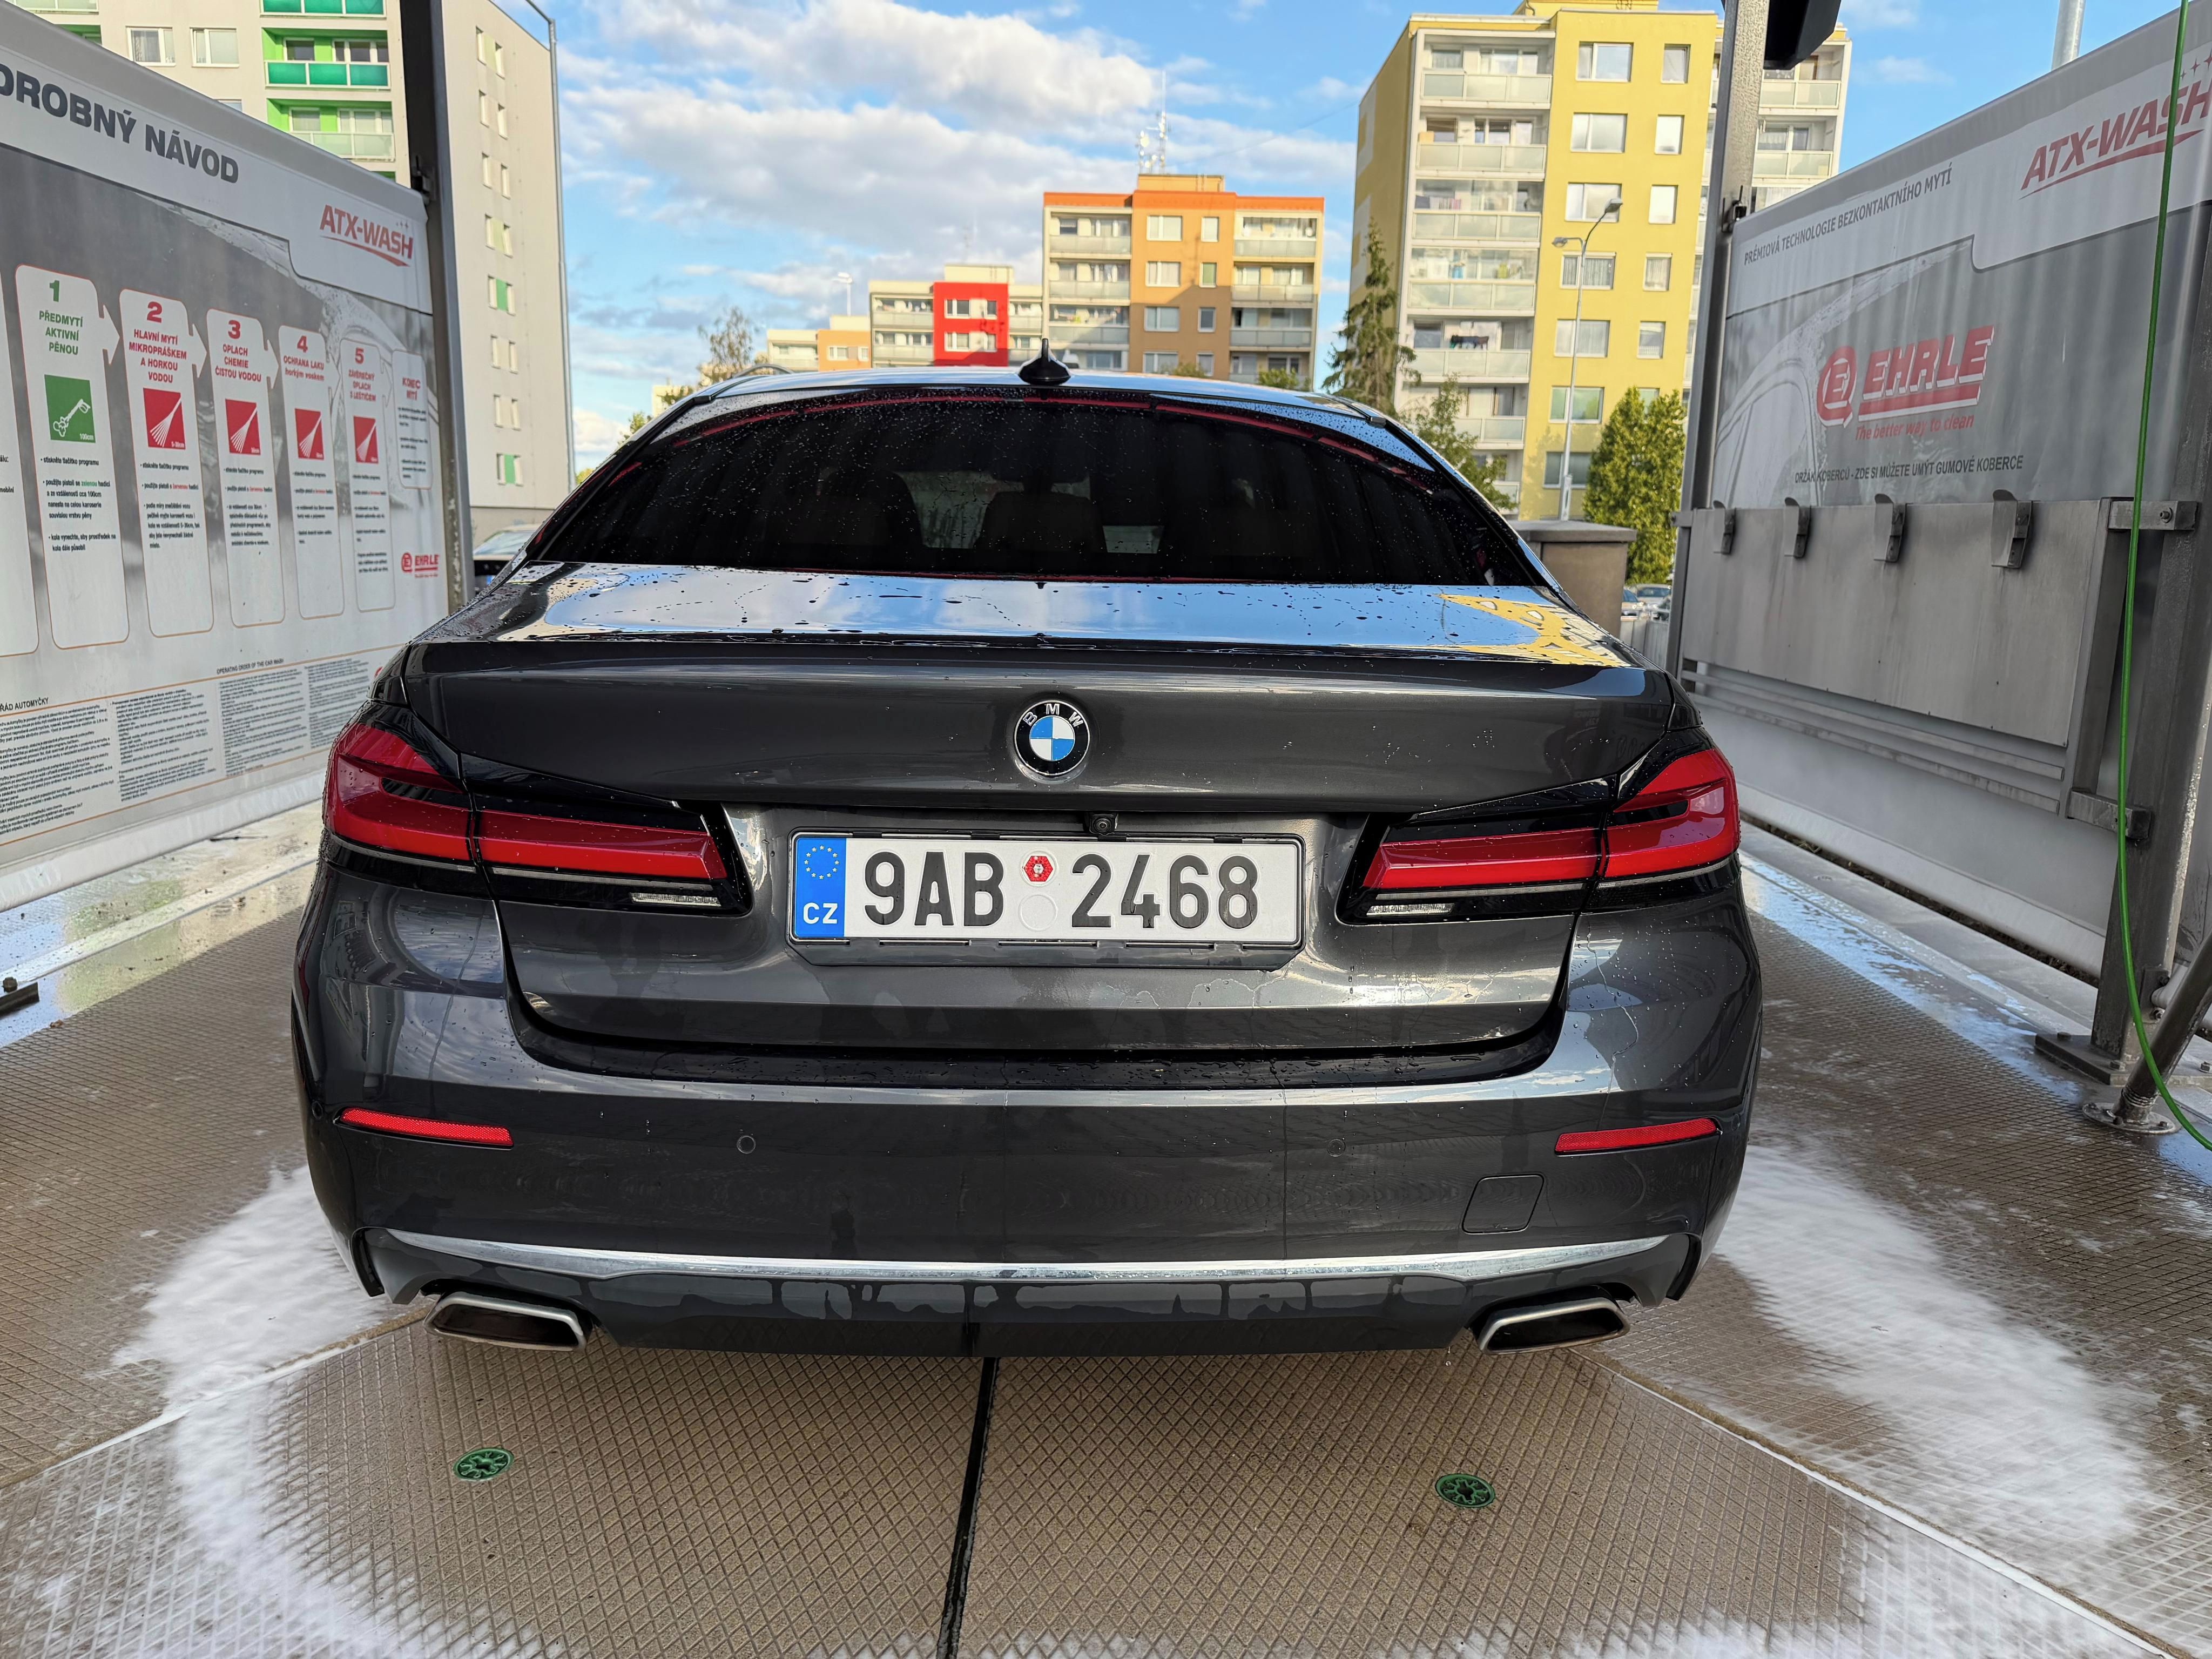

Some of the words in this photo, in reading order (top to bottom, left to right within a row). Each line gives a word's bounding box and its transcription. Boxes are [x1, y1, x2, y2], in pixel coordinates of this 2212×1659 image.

[145, 124, 239, 184] NÁVOD
[1744, 235, 1780, 265] PRÉMIOVÁ
[1782, 217, 1836, 251] TECHNOLOGIE
[1838, 181, 1921, 229] BEZKONTAKTNÍHO
[1924, 162, 1952, 194] MYTÍ
[320, 204, 413, 259] ATX-WASH
[49, 280, 60, 302] 1
[39, 309, 83, 327] PŘEDMYTÍ
[146, 301, 162, 323] 2
[45, 327, 79, 341] AKTIVNÍ
[134, 329, 159, 342] HLAVNÍ
[161, 334, 178, 345] MYTÍ
[228, 320, 241, 339] 3
[49, 341, 78, 355] PĚNOU
[129, 342, 187, 360] MIKROPRÁŠKEM
[223, 343, 248, 356] OPLACH
[296, 335, 308, 353] 4
[140, 357, 145, 366] A
[148, 358, 178, 371] HORKOU
[224, 356, 248, 368] CHEMIE
[355, 347, 364, 364] 5
[1863, 325, 1994, 401] EHRLE
[149, 372, 173, 383] VODOU
[215, 366, 237, 378] ČISTOU
[238, 370, 261, 382] VODOU
[1856, 426, 1872, 440] The
[1873, 424, 1903, 439] better
[1906, 422, 1927, 437] way
[1930, 419, 1940, 431] to
[1944, 414, 1974, 429] clean
[1795, 468, 1815, 483] DRŽÁK
[1816, 466, 1850, 482] KOBERCŮ
[1854, 467, 1870, 480] ZDE
[1871, 467, 1878, 478] SI
[1879, 462, 1911, 478] MŮŽETE
[1912, 459, 1935, 476] UMÝT
[1936, 455, 1975, 474] GUMOVÉ
[1977, 455, 2024, 472] KOBERCE
[15, 697, 49, 710] AUTOMYČKY
[1022, 703, 1084, 727] BMW
[864, 851, 1005, 928] 9AB
[1070, 853, 1259, 930] 2468
[802, 902, 838, 925] CZ
